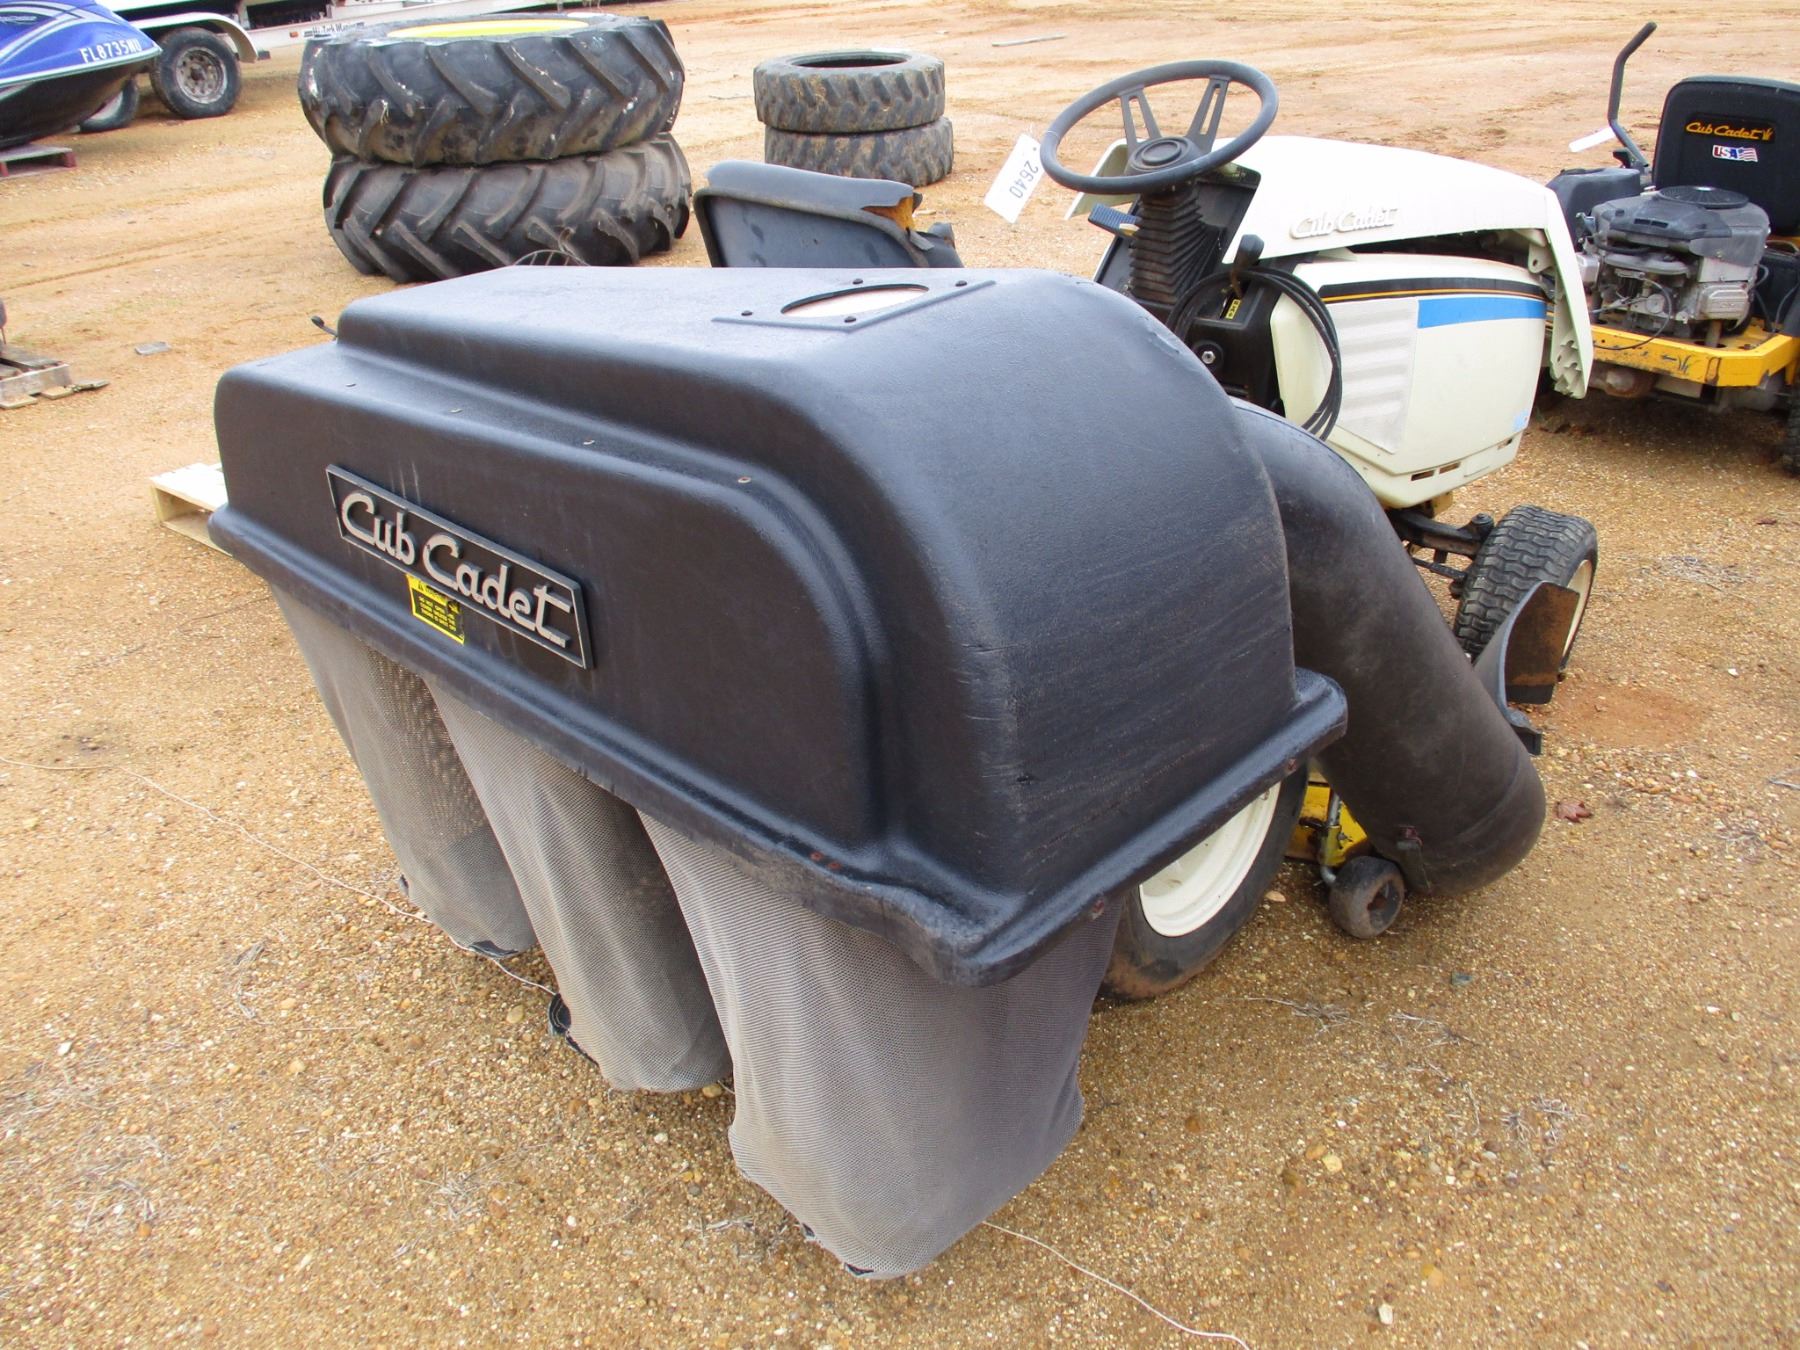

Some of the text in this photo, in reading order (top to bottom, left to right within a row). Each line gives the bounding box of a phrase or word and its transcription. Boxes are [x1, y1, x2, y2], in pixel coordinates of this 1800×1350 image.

[1685, 122, 1762, 139] Cub Cadet
[1713, 145, 1738, 159] USA
[1009, 160, 1039, 199] 2640
[1290, 206, 1398, 240] Cub Cadet
[341, 490, 574, 649] Cub Cadet
